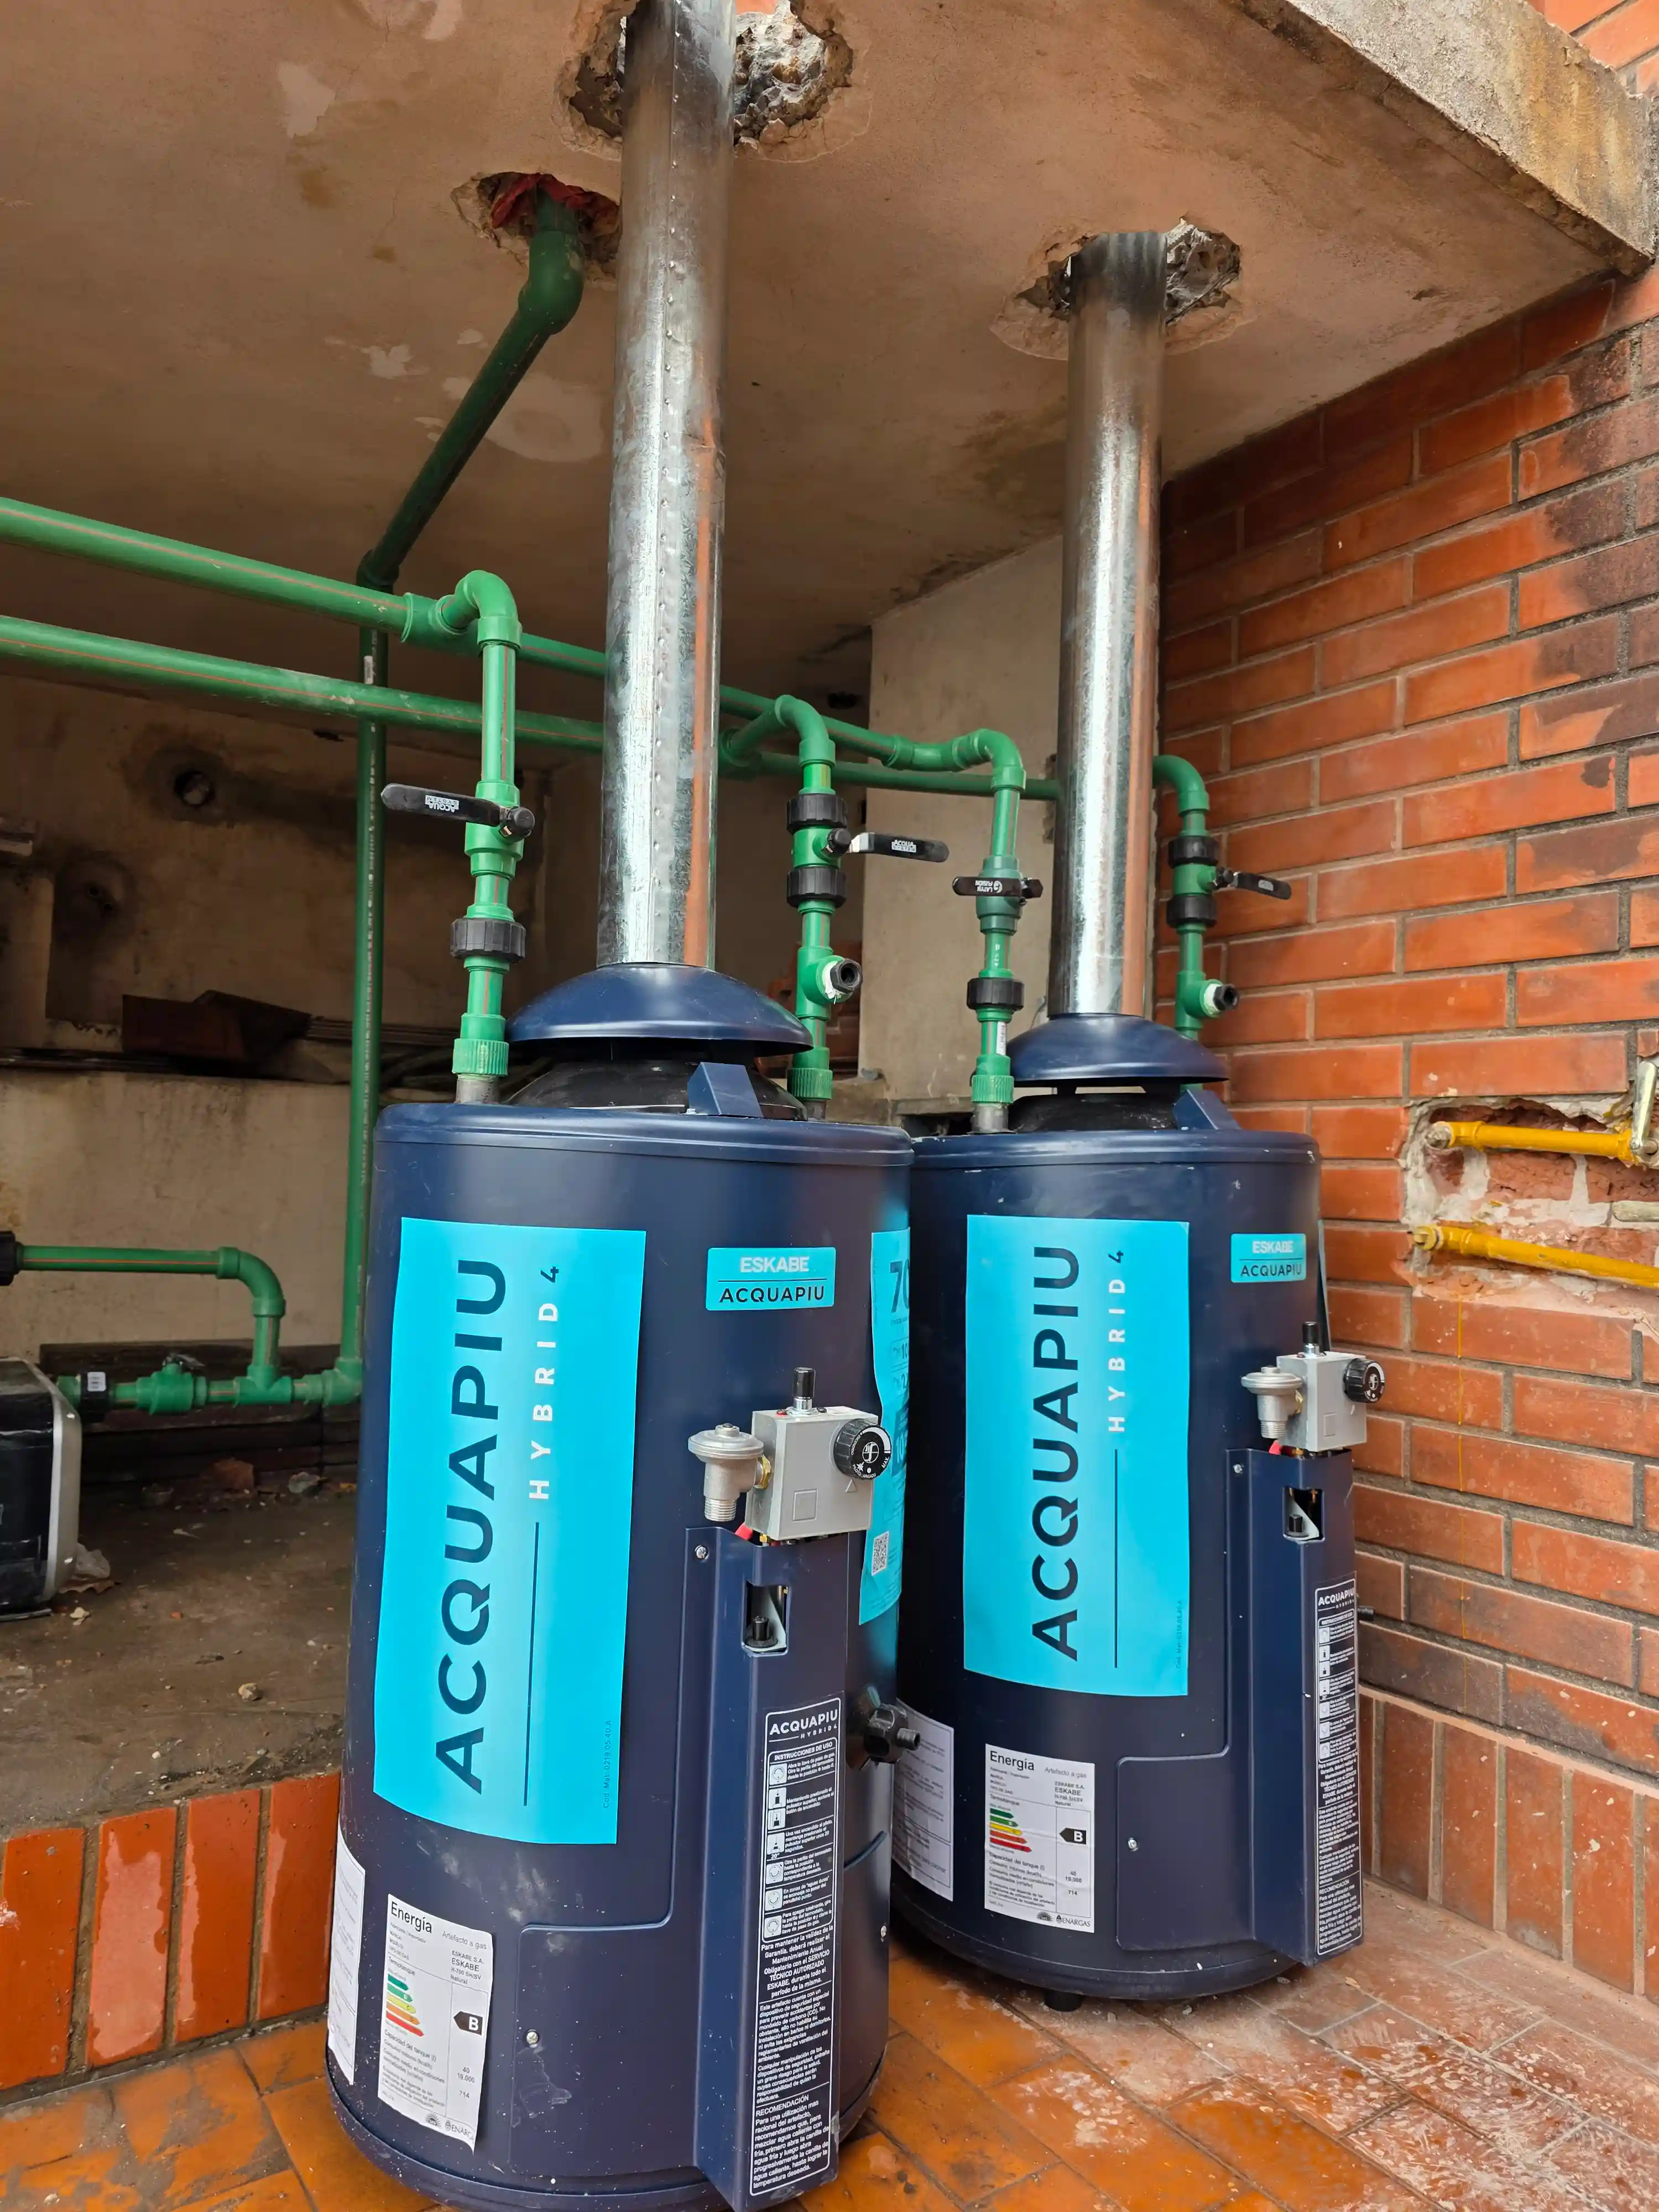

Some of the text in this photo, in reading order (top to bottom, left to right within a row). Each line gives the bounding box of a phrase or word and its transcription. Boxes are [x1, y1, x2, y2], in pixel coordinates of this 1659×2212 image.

[1252, 1240, 1294, 1254] ESKABE
[740, 1256, 810, 1273] ESKABE
[1240, 1264, 1302, 1277] ACQUAPIU
[719, 1285, 825, 1303] ACQUAPIU
[1108, 1249, 1125, 1432] HYBRID 4
[529, 1266, 560, 1500] HYBRID 4
[1031, 1246, 1079, 1662] ACQUAPIU
[881, 1457, 890, 1469] MAX.
[435, 1260, 507, 1796] ACQUAPIU
[1318, 1587, 1354, 1606] ACQUAPIU
[769, 1709, 837, 1736] ACQUAPIU
[774, 1747, 814, 1761] INSTRUCCIONES
[990, 1750, 1034, 1771] Energía
[1055, 1787, 1081, 1796] ESKABE
[1073, 1830, 1083, 1842] B
[391, 1901, 432, 1933] Energía
[1062, 1917, 1091, 1927] ENARGAS
[442, 1931, 468, 1944] Artefacto
[775, 1936, 799, 1948] mantener
[805, 1928, 821, 1939] validez
[789, 1941, 805, 1952] deberá
[807, 1935, 824, 1947] realizar
[452, 1950, 472, 1961] ESKABE
[764, 1961, 791, 1975] Obligatorio
[792, 1959, 801, 1968] con
[807, 1948, 830, 1963] SERVICIO
[772, 1943, 823, 1964] Mantenimiento Anual
[451, 1966, 465, 1975] H-700
[452, 1958, 479, 1971] ESKABE
[793, 1958, 824, 1975] AUTORIZADO
[791, 1971, 810, 1984] durante
[811, 1968, 821, 1978] todo
[792, 1984, 797, 1992] de
[468, 2016, 479, 2031] B
[457, 2073, 475, 2083] 19.000
[755, 2095, 808, 2116] RECOMENDACIÓN
[755, 2117, 769, 2125] Para
[781, 2104, 807, 2118] utilización
[755, 2123, 776, 2133] racional
[778, 2119, 786, 2127] del
[755, 2125, 796, 2140] recomendamos
[778, 2134, 791, 2143] agua
[813, 2121, 822, 2129] con
[784, 2145, 799, 2156] luego
